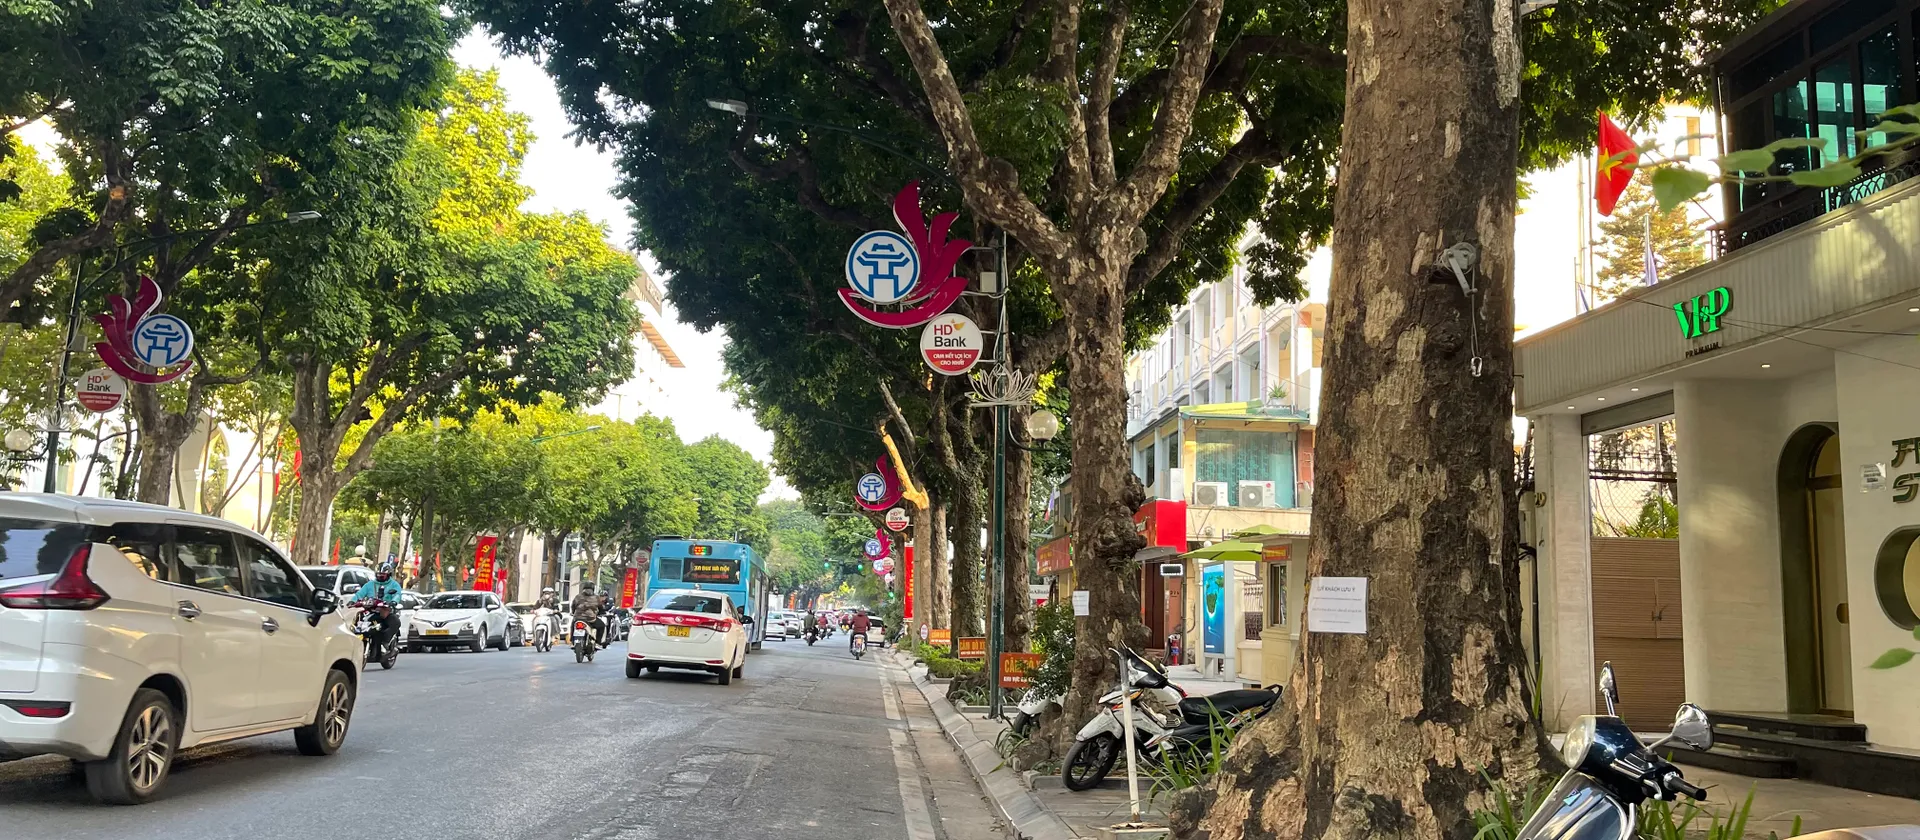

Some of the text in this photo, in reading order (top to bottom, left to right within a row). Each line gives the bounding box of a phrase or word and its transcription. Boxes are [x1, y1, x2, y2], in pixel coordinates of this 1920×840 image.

[1673, 286, 1731, 339] VIP
[934, 324, 953, 335] HD
[934, 336, 966, 347] Bank
[87, 375, 102, 383] HD
[87, 383, 111, 392] Bank
